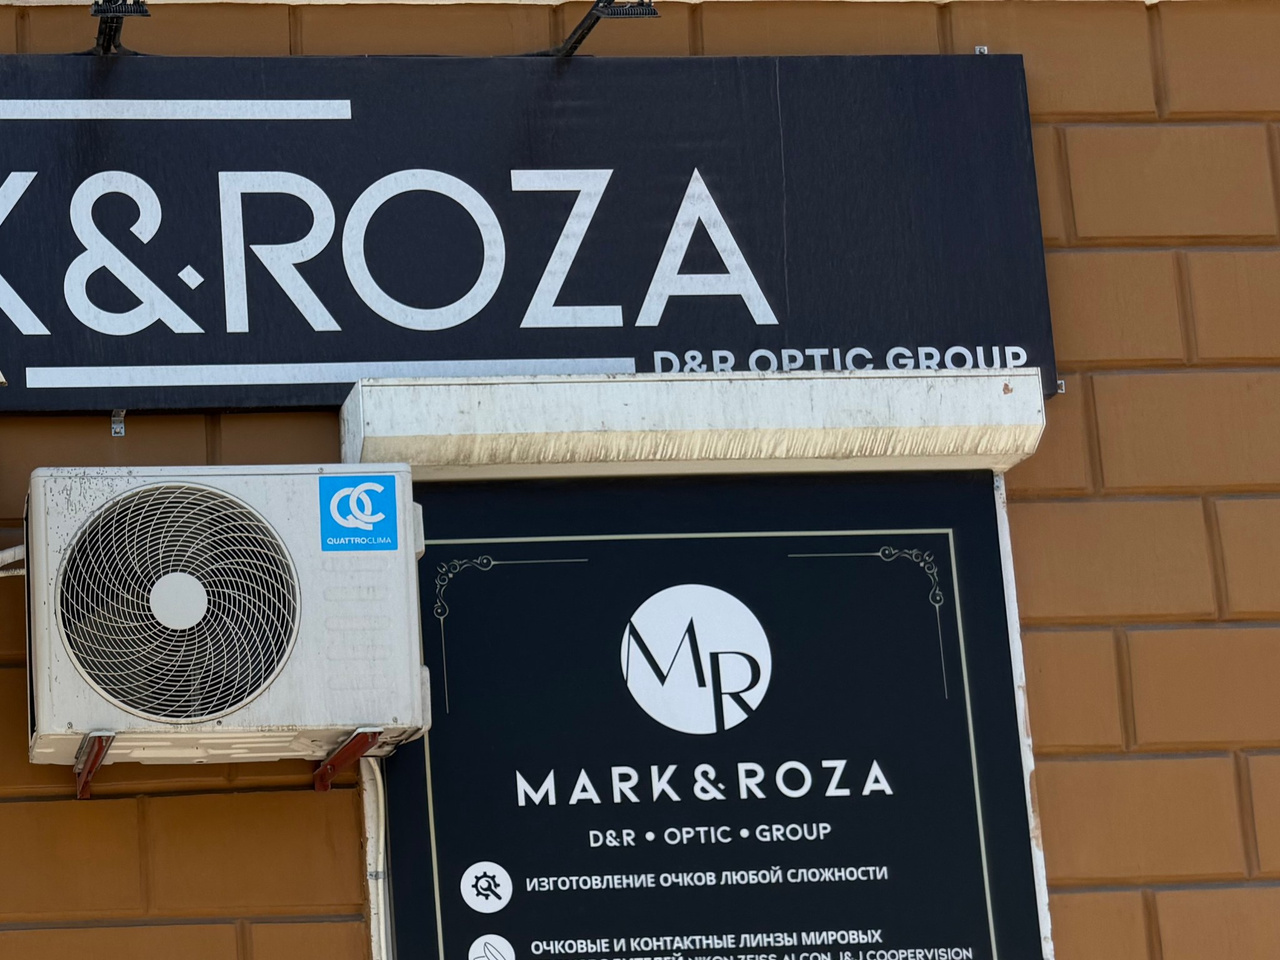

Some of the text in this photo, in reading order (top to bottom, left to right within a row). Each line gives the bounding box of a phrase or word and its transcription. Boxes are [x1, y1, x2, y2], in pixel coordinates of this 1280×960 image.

[653, 345, 1029, 374] D&R OPTIC GROUP
[327, 537, 392, 545] QUATTROCLIMA
[516, 759, 894, 807] MARK&ROZA
[589, 823, 832, 848] D&R OPTIC GROUP
[526, 866, 888, 892] ИЗГОТОВЛЕНИЕ ОЧКОВ ЛЮБОЙ СЛОЖНОСТИ
[531, 929, 883, 955] ОЧКОВЫЕ И КОНТАКТНЫЕ ЛИНЗЫ МИРОВЫХ
